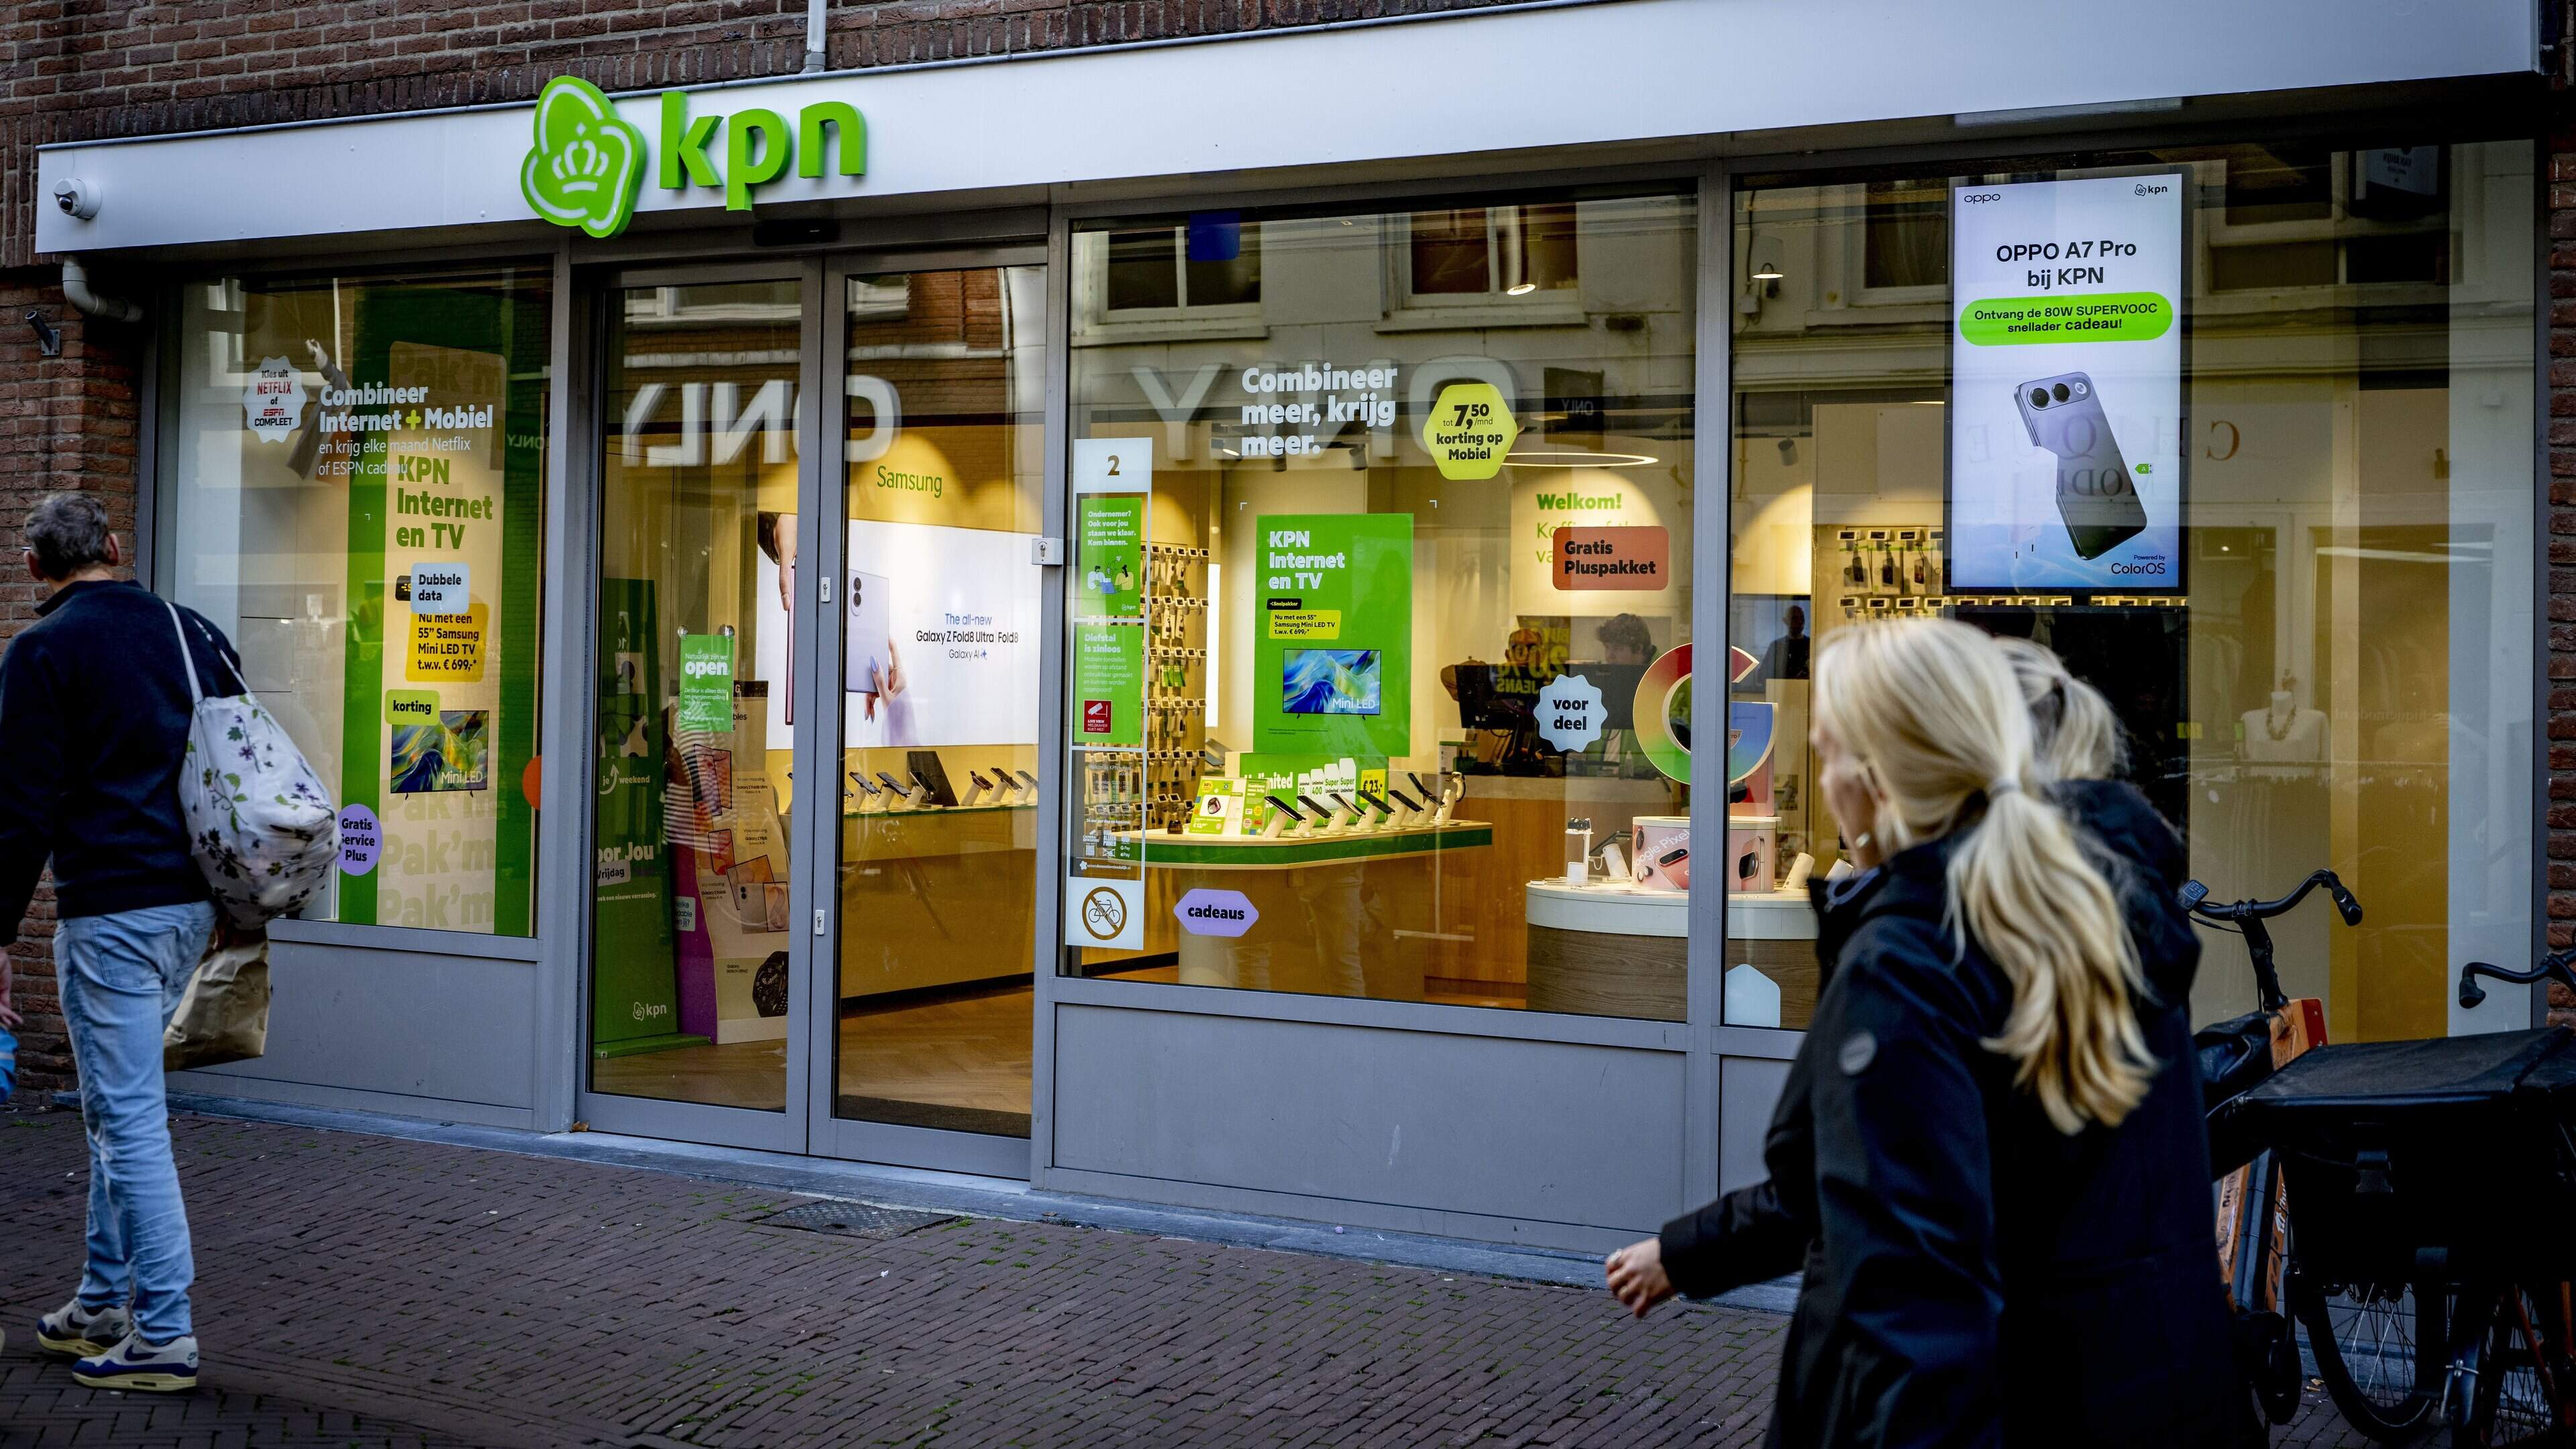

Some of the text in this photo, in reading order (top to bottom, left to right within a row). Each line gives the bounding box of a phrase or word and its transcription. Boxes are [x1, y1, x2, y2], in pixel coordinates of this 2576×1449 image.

[659, 91, 867, 211] kpn
[2147, 184, 2167, 195] kpn
[1964, 193, 2000, 204] oppo
[1996, 240, 2137, 262] OPPO A7 Pro
[2028, 267, 2104, 290] bij KPN
[1975, 303, 2157, 321] Ontvang de 80W SUPERVOOC
[2008, 318, 2123, 333] snellader cadeau!
[262, 369, 288, 378] Kies uit
[1242, 362, 1397, 393] Combineer
[257, 380, 292, 395] NETFLIX
[321, 381, 429, 407] Combineer
[270, 396, 278, 405] of
[263, 408, 285, 417] ESPN
[1242, 392, 1396, 427] meer, krijg
[254, 417, 292, 427] COMPLEET
[319, 409, 402, 433] Internet
[425, 404, 493, 430] Mobiel
[319, 436, 471, 457] en krijg elke maand Netflix
[1242, 435, 1321, 456] meer.
[1436, 432, 1503, 447] korting op
[1448, 447, 1491, 461] Mobiel
[319, 463, 329, 476] of
[333, 462, 364, 476] ESPN
[398, 455, 449, 485] KPN
[1108, 455, 1120, 476] 2
[876, 466, 943, 498] Samsung
[397, 488, 493, 521] Internet
[1536, 493, 1622, 510] Welkom!
[1088, 510, 1132, 518] Ondernemer?
[396, 523, 466, 549] en TV
[1269, 531, 1310, 547] KPN
[1564, 539, 1613, 555] Gratis
[1269, 552, 1345, 568] Internet
[1564, 559, 1656, 578] Pluspakket
[2111, 562, 2166, 575] ColorOS
[419, 574, 462, 586] Dubbele
[1269, 573, 1323, 589] en TV
[419, 590, 442, 601] data
[419, 613, 472, 624] Nu met een
[945, 613, 992, 626] The all-new
[437, 628, 479, 641] Samsung
[916, 631, 1018, 645] Galaxy Z Fold8 Ultra Fold8
[1084, 633, 1116, 642] Diefstal
[418, 643, 476, 655] Mini LED TV
[949, 649, 979, 661] Galaxy AI
[1092, 645, 1121, 653] zinloos
[418, 660, 441, 670] t.w.v.
[443, 659, 449, 670] €
[393, 700, 431, 715] korting
[1332, 698, 1376, 709] Mini LED
[1553, 699, 1589, 710] voor
[1554, 716, 1587, 730] deel
[441, 770, 483, 784] Mini LED
[619, 775, 650, 784] weekend
[1325, 778, 1339, 787] Super
[1340, 777, 1354, 786] Super
[1311, 787, 1322, 795] 400
[341, 818, 372, 830] Gratis
[345, 849, 368, 862] Plus
[625, 841, 655, 861] Jou
[1187, 904, 1244, 922] cadeaus
[646, 1003, 667, 1018] kpn
